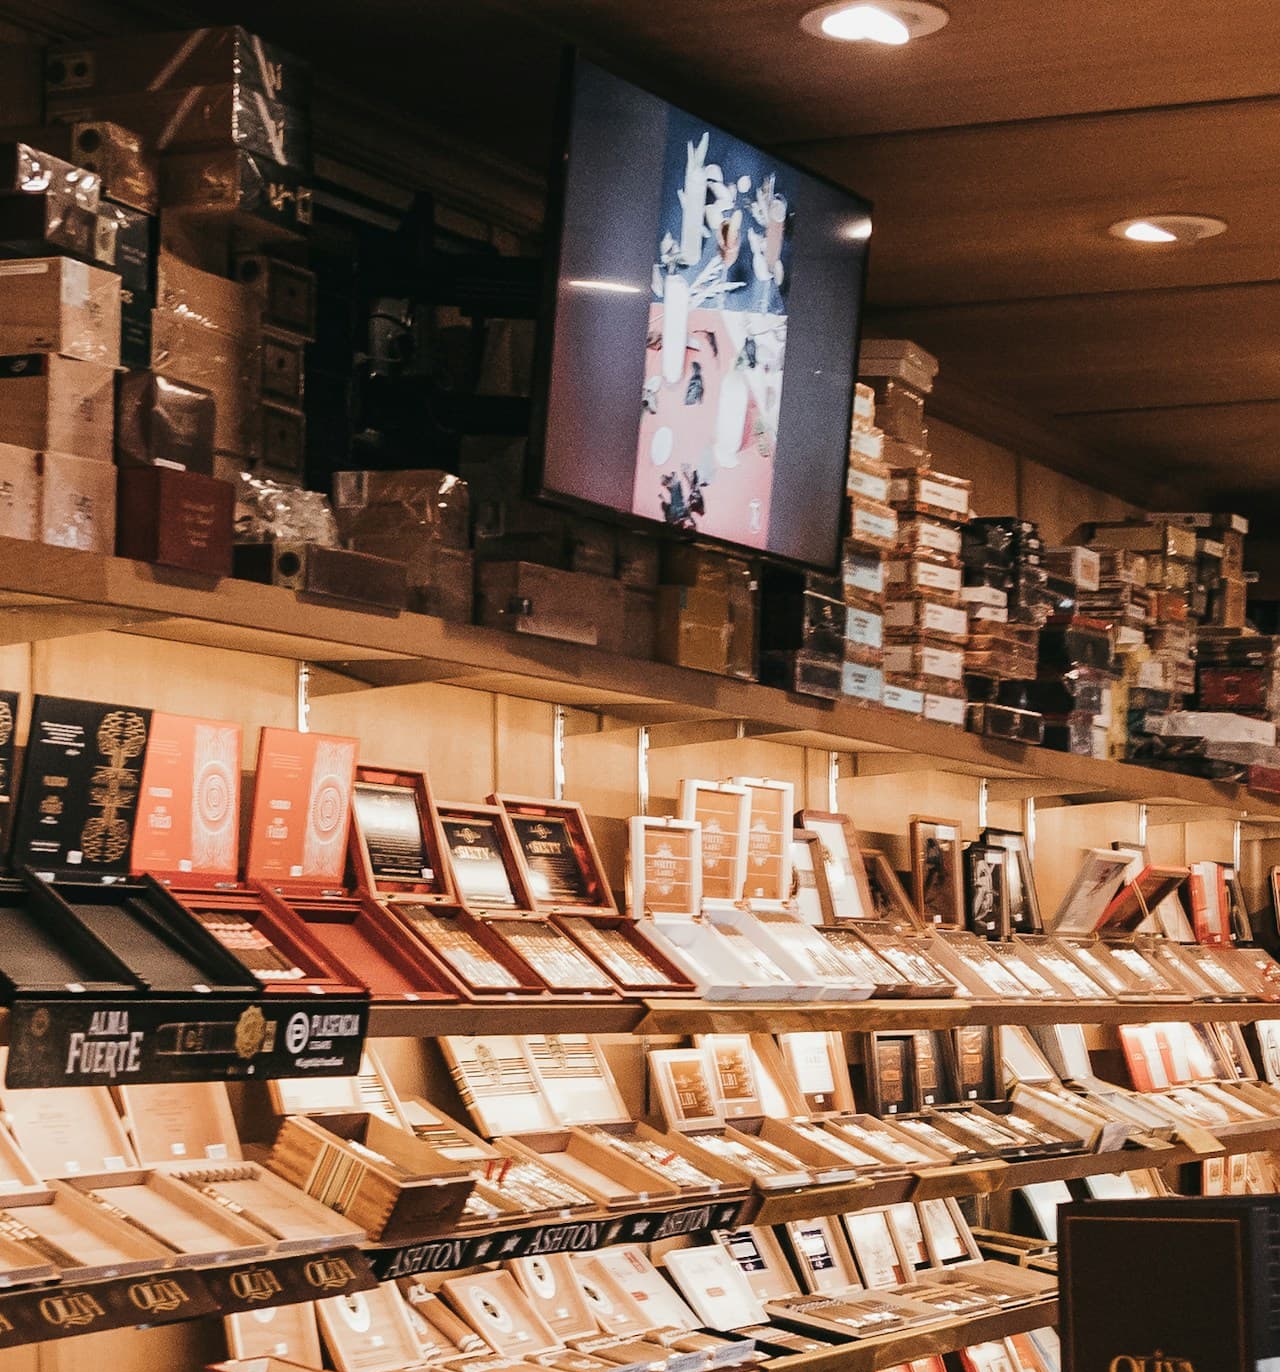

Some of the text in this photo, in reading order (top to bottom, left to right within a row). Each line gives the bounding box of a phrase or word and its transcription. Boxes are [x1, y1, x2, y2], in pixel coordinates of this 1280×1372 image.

[455, 845, 489, 859] SIXTY
[88, 1010, 130, 1036] ALMA
[65, 1031, 144, 1078] FUERTE
[528, 1222, 599, 1256] ASHTON
[653, 1204, 713, 1240] ASHTON
[303, 1255, 359, 1292] OLIVA
[388, 1240, 469, 1278] ASHTON
[127, 1275, 190, 1314] OLIVA
[229, 1264, 283, 1303] OLIVA
[39, 1291, 107, 1329] OLIVA
